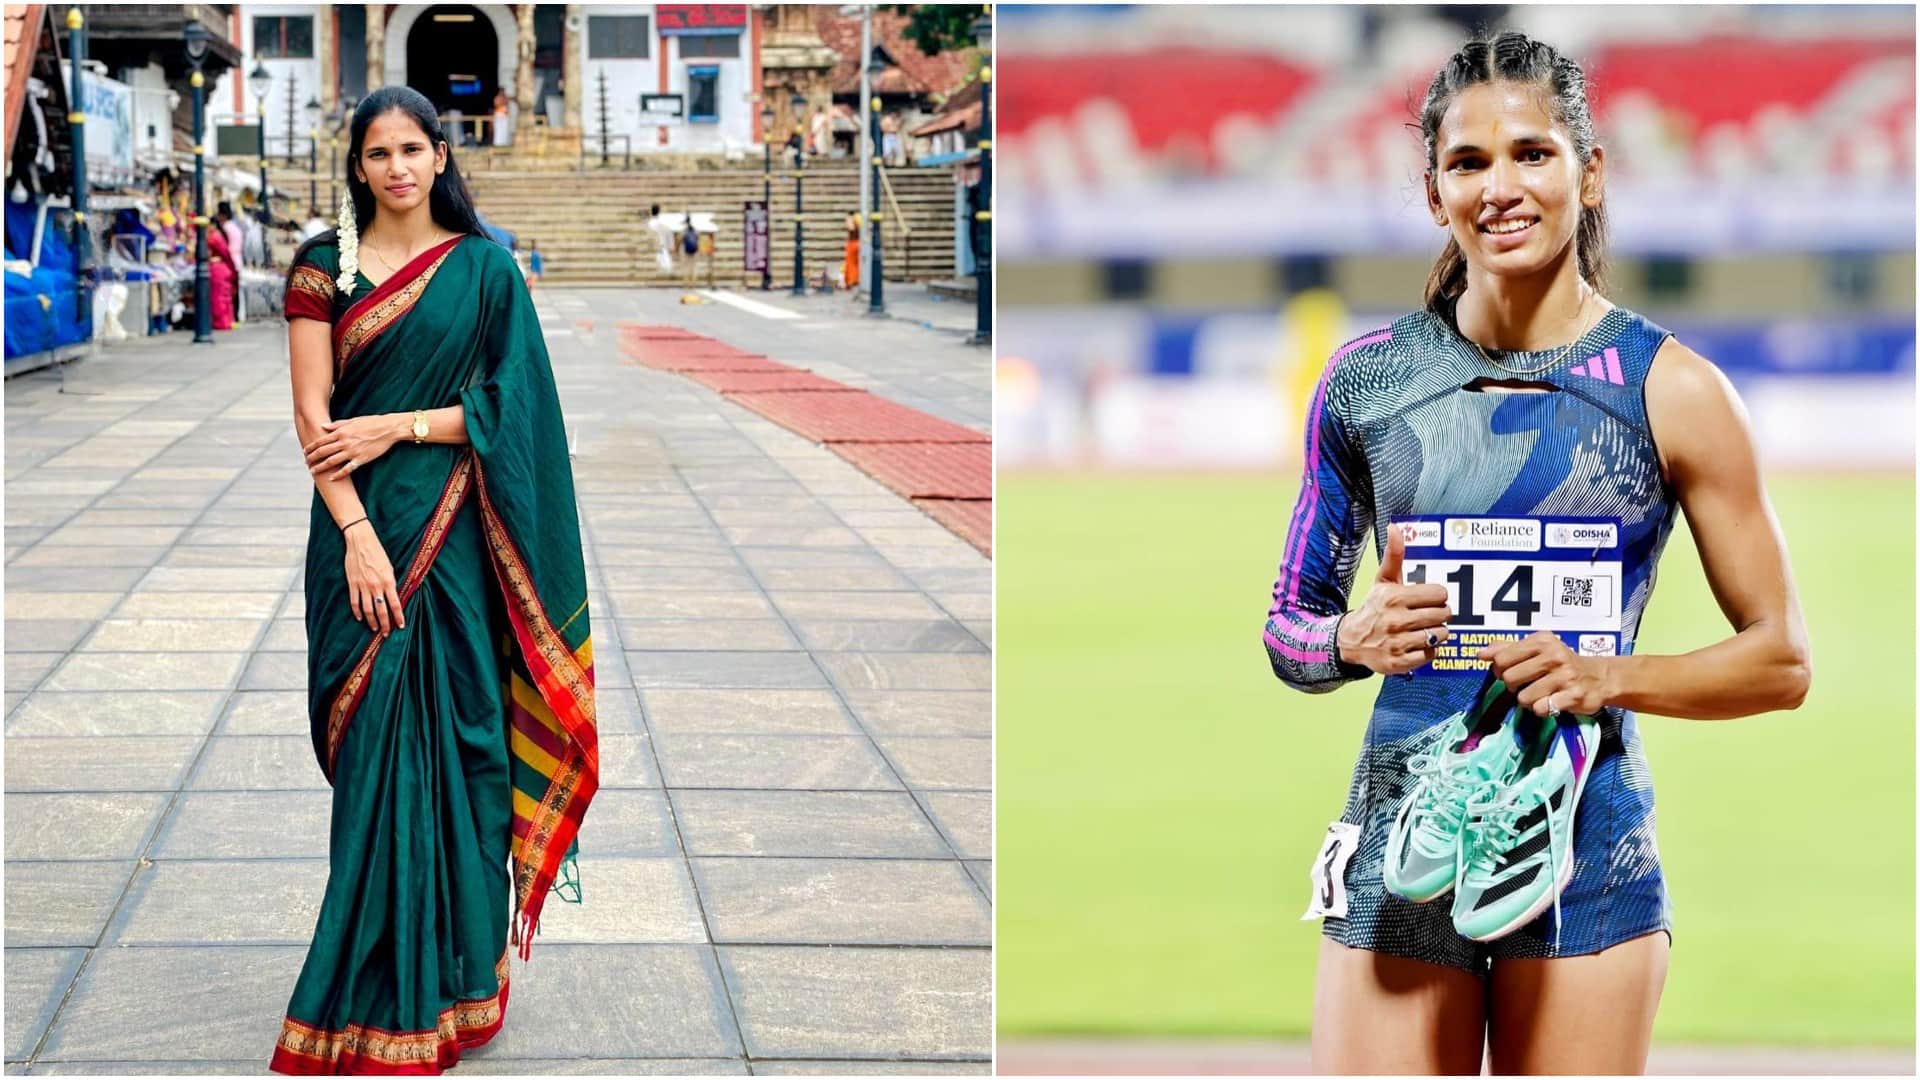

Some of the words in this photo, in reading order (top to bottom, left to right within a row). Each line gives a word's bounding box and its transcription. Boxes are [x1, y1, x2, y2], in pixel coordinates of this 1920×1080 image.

[1471, 521, 1534, 537] Reliance
[1573, 529, 1611, 539] ODISHA
[1471, 536, 1534, 549] Foundation
[1321, 839, 1342, 909] 3
